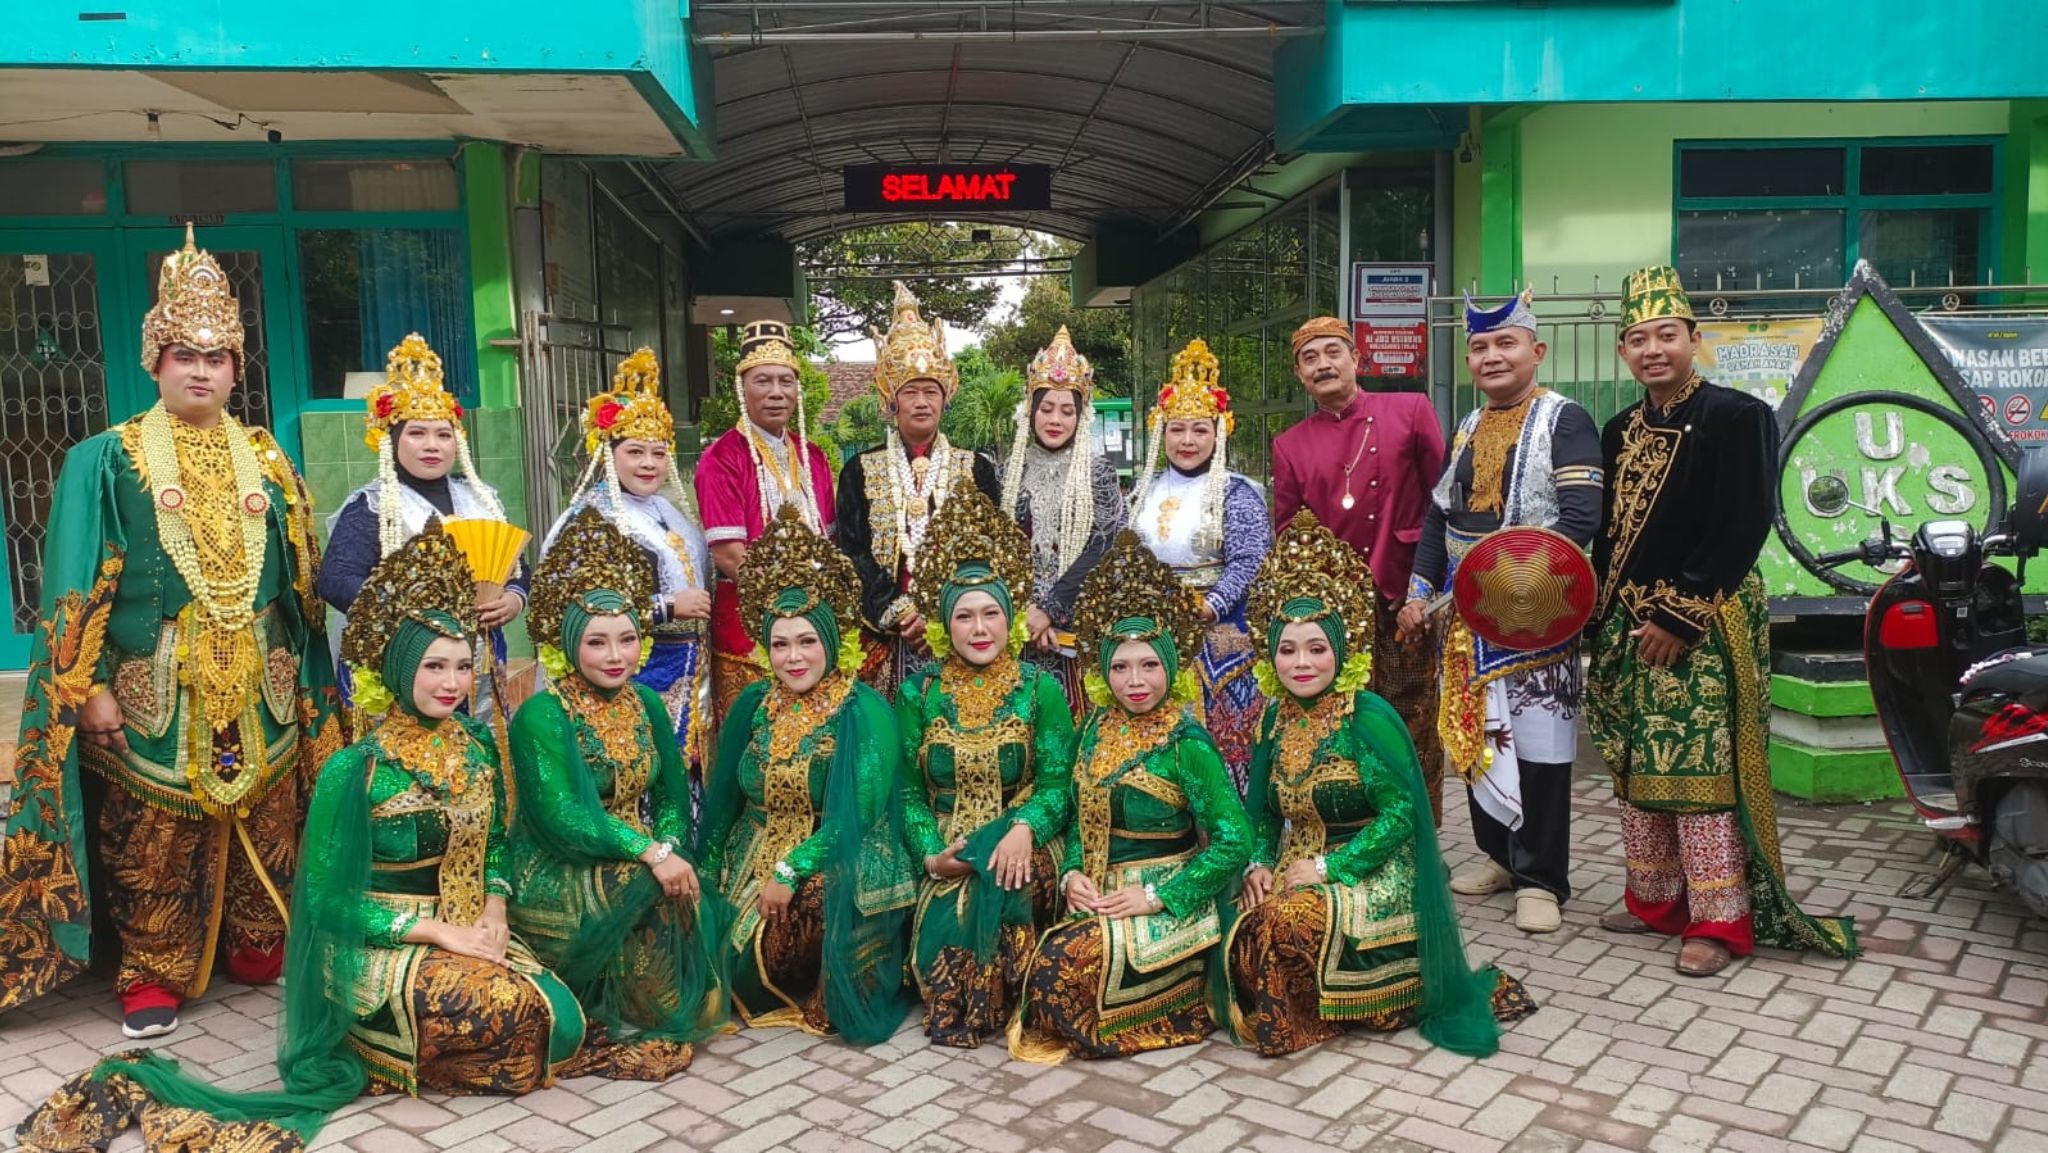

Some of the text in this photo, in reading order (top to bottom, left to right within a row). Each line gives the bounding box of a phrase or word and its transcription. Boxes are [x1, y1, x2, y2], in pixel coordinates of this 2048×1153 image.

[881, 173, 1017, 201] SELAMAT
[1717, 343, 1799, 361] MADRASAH
[1958, 369, 1994, 388] SAP
